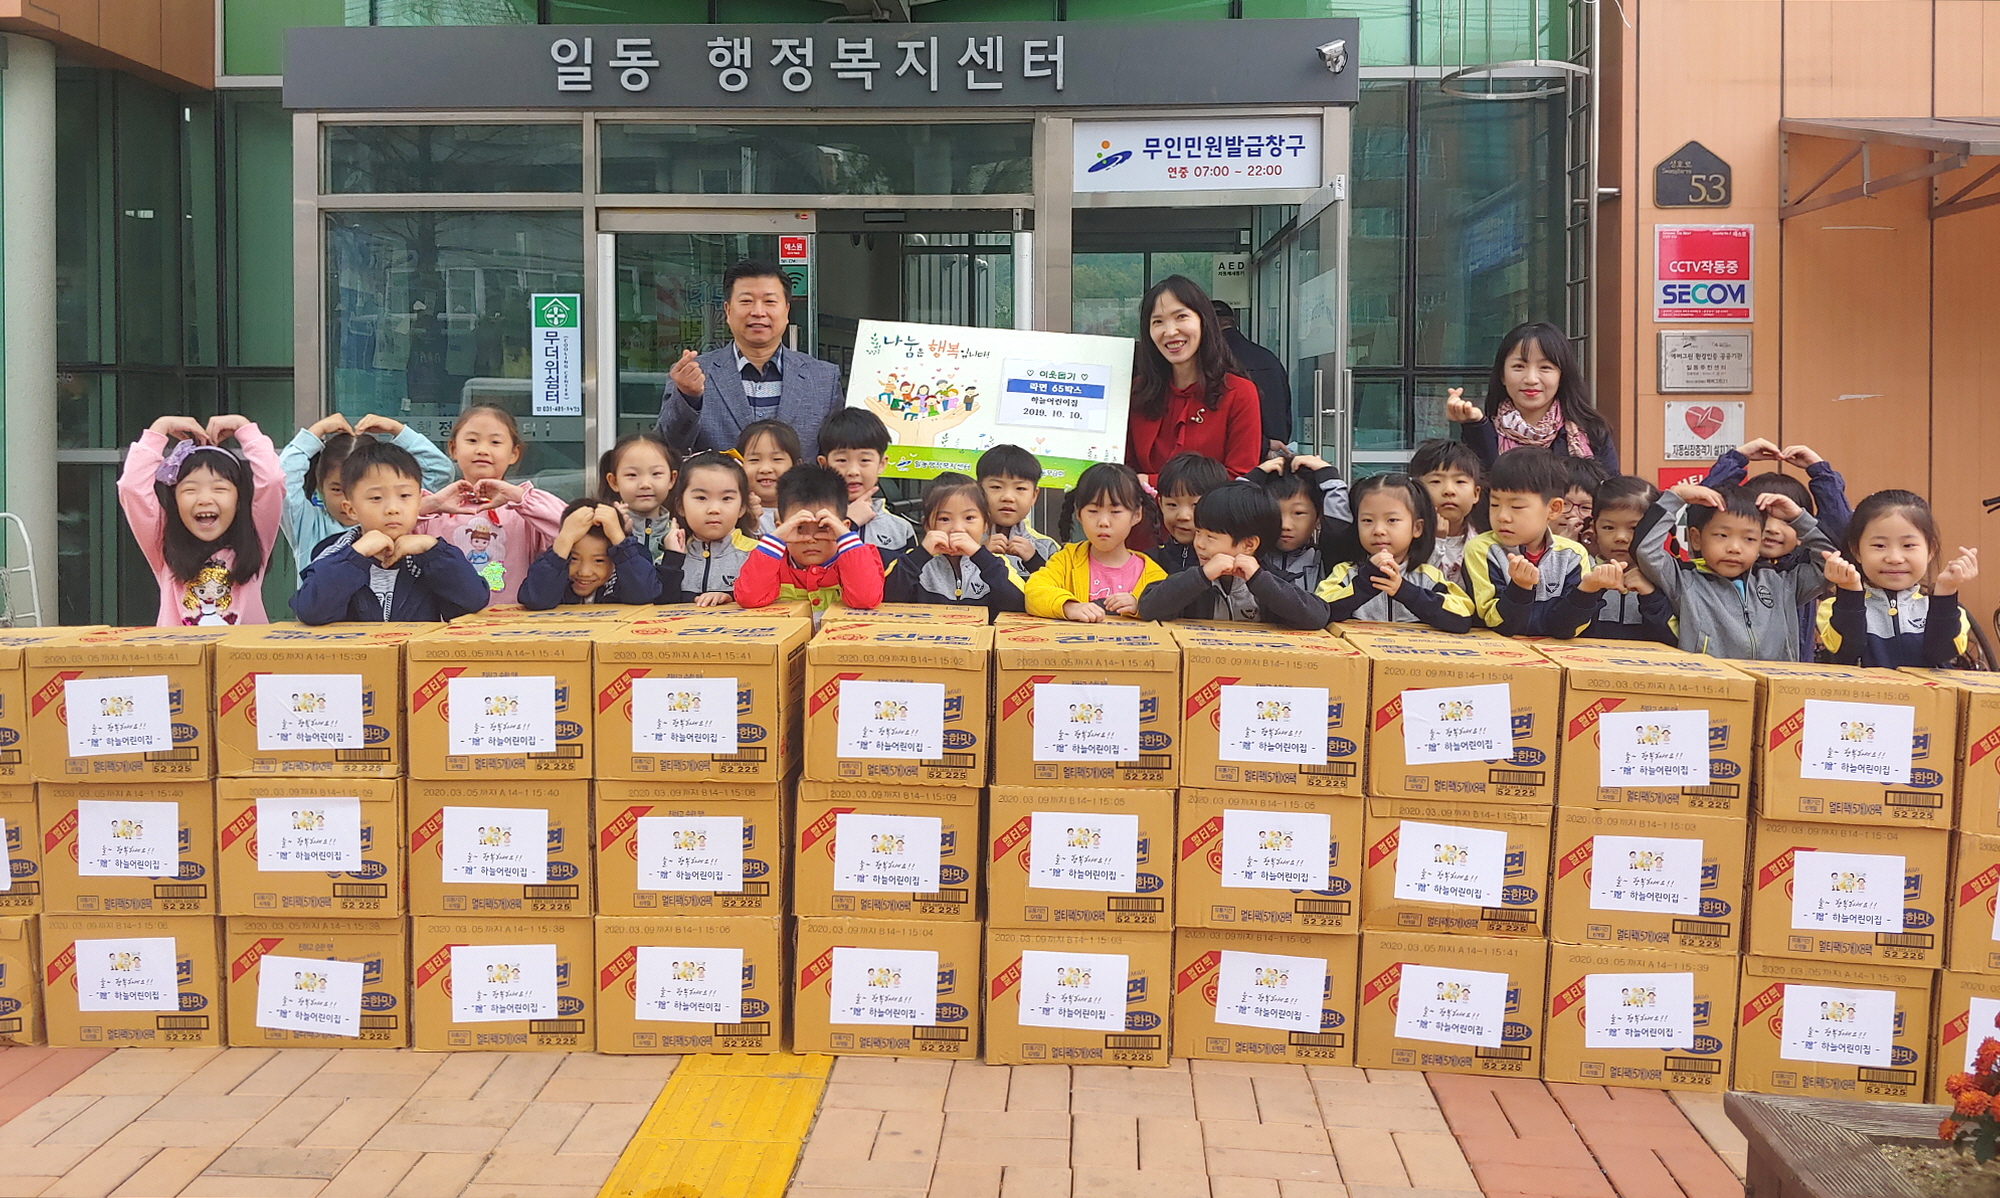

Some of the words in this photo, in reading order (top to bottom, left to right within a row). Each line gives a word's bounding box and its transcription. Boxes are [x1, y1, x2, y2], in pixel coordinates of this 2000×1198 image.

[550, 37, 660, 93] 일동
[707, 35, 1066, 93] 행정복지센터
[1142, 133, 1307, 161] 무인민원발급창구
[1166, 165, 1190, 180] 연중
[1193, 164, 1230, 179] 07:00
[1246, 163, 1283, 178] 22:00
[1688, 174, 1726, 202] 53
[784, 242, 803, 251] 에스원
[1218, 261, 1245, 270] AED
[1669, 260, 1739, 274] CCTV작동중
[1662, 283, 1745, 304] SECOM
[883, 334, 925, 359] 나눔은
[543, 331, 560, 404] 무더위쉼터
[1029, 382, 1048, 392] 라면
[1051, 383, 1083, 394] 65박스
[1031, 396, 1078, 407] 하늘어린이집
[1023, 407, 1047, 417] 2019.
[1052, 410, 1065, 418] 10.
[1069, 411, 1083, 420] 10.
[107, 736, 152, 746] 하늘어린이집
[296, 733, 343, 742] 하늘어린이집
[488, 736, 535, 746] 하늘어린이집
[671, 733, 717, 743] 하늘어린이집
[876, 741, 923, 752] 하늘어린이집
[1072, 744, 1119, 754] 하늘어린이집
[1259, 742, 1307, 753] 하늘어린이집
[1445, 740, 1492, 751] 하늘어린이집
[1640, 766, 1688, 775] 하늘어린이집
[1841, 763, 1890, 775] 하늘어린이집
[296, 852, 341, 860] 하늘어린이집
[115, 859, 159, 870] 하늘어린이집
[481, 867, 527, 877] 하늘어린이집
[676, 871, 723, 880] 하늘어린이집
[1069, 869, 1116, 880] 하늘어린이집
[1261, 871, 1308, 882] 하늘어린이집
[873, 875, 919, 886] 하늘어린이집
[1434, 885, 1482, 899] 하늘어린이집
[1630, 891, 1679, 903] 하늘어린이집
[1833, 913, 1882, 925] 하늘어린이집
[115, 991, 159, 1000] 하늘어린이집
[491, 1003, 537, 1013] 하늘어린이집
[674, 1001, 721, 1012] 하늘어린이집
[295, 1011, 341, 1024] 하늘어린이집
[869, 1008, 916, 1018] 하늘어린이집
[1058, 1007, 1105, 1019] 하늘어린이집
[1255, 1007, 1301, 1020] 하늘어린이집
[1436, 1022, 1483, 1035] 하늘어린이집
[1625, 1028, 1673, 1037] 하늘어린이집
[1822, 1043, 1871, 1055] 하늘어린이집
